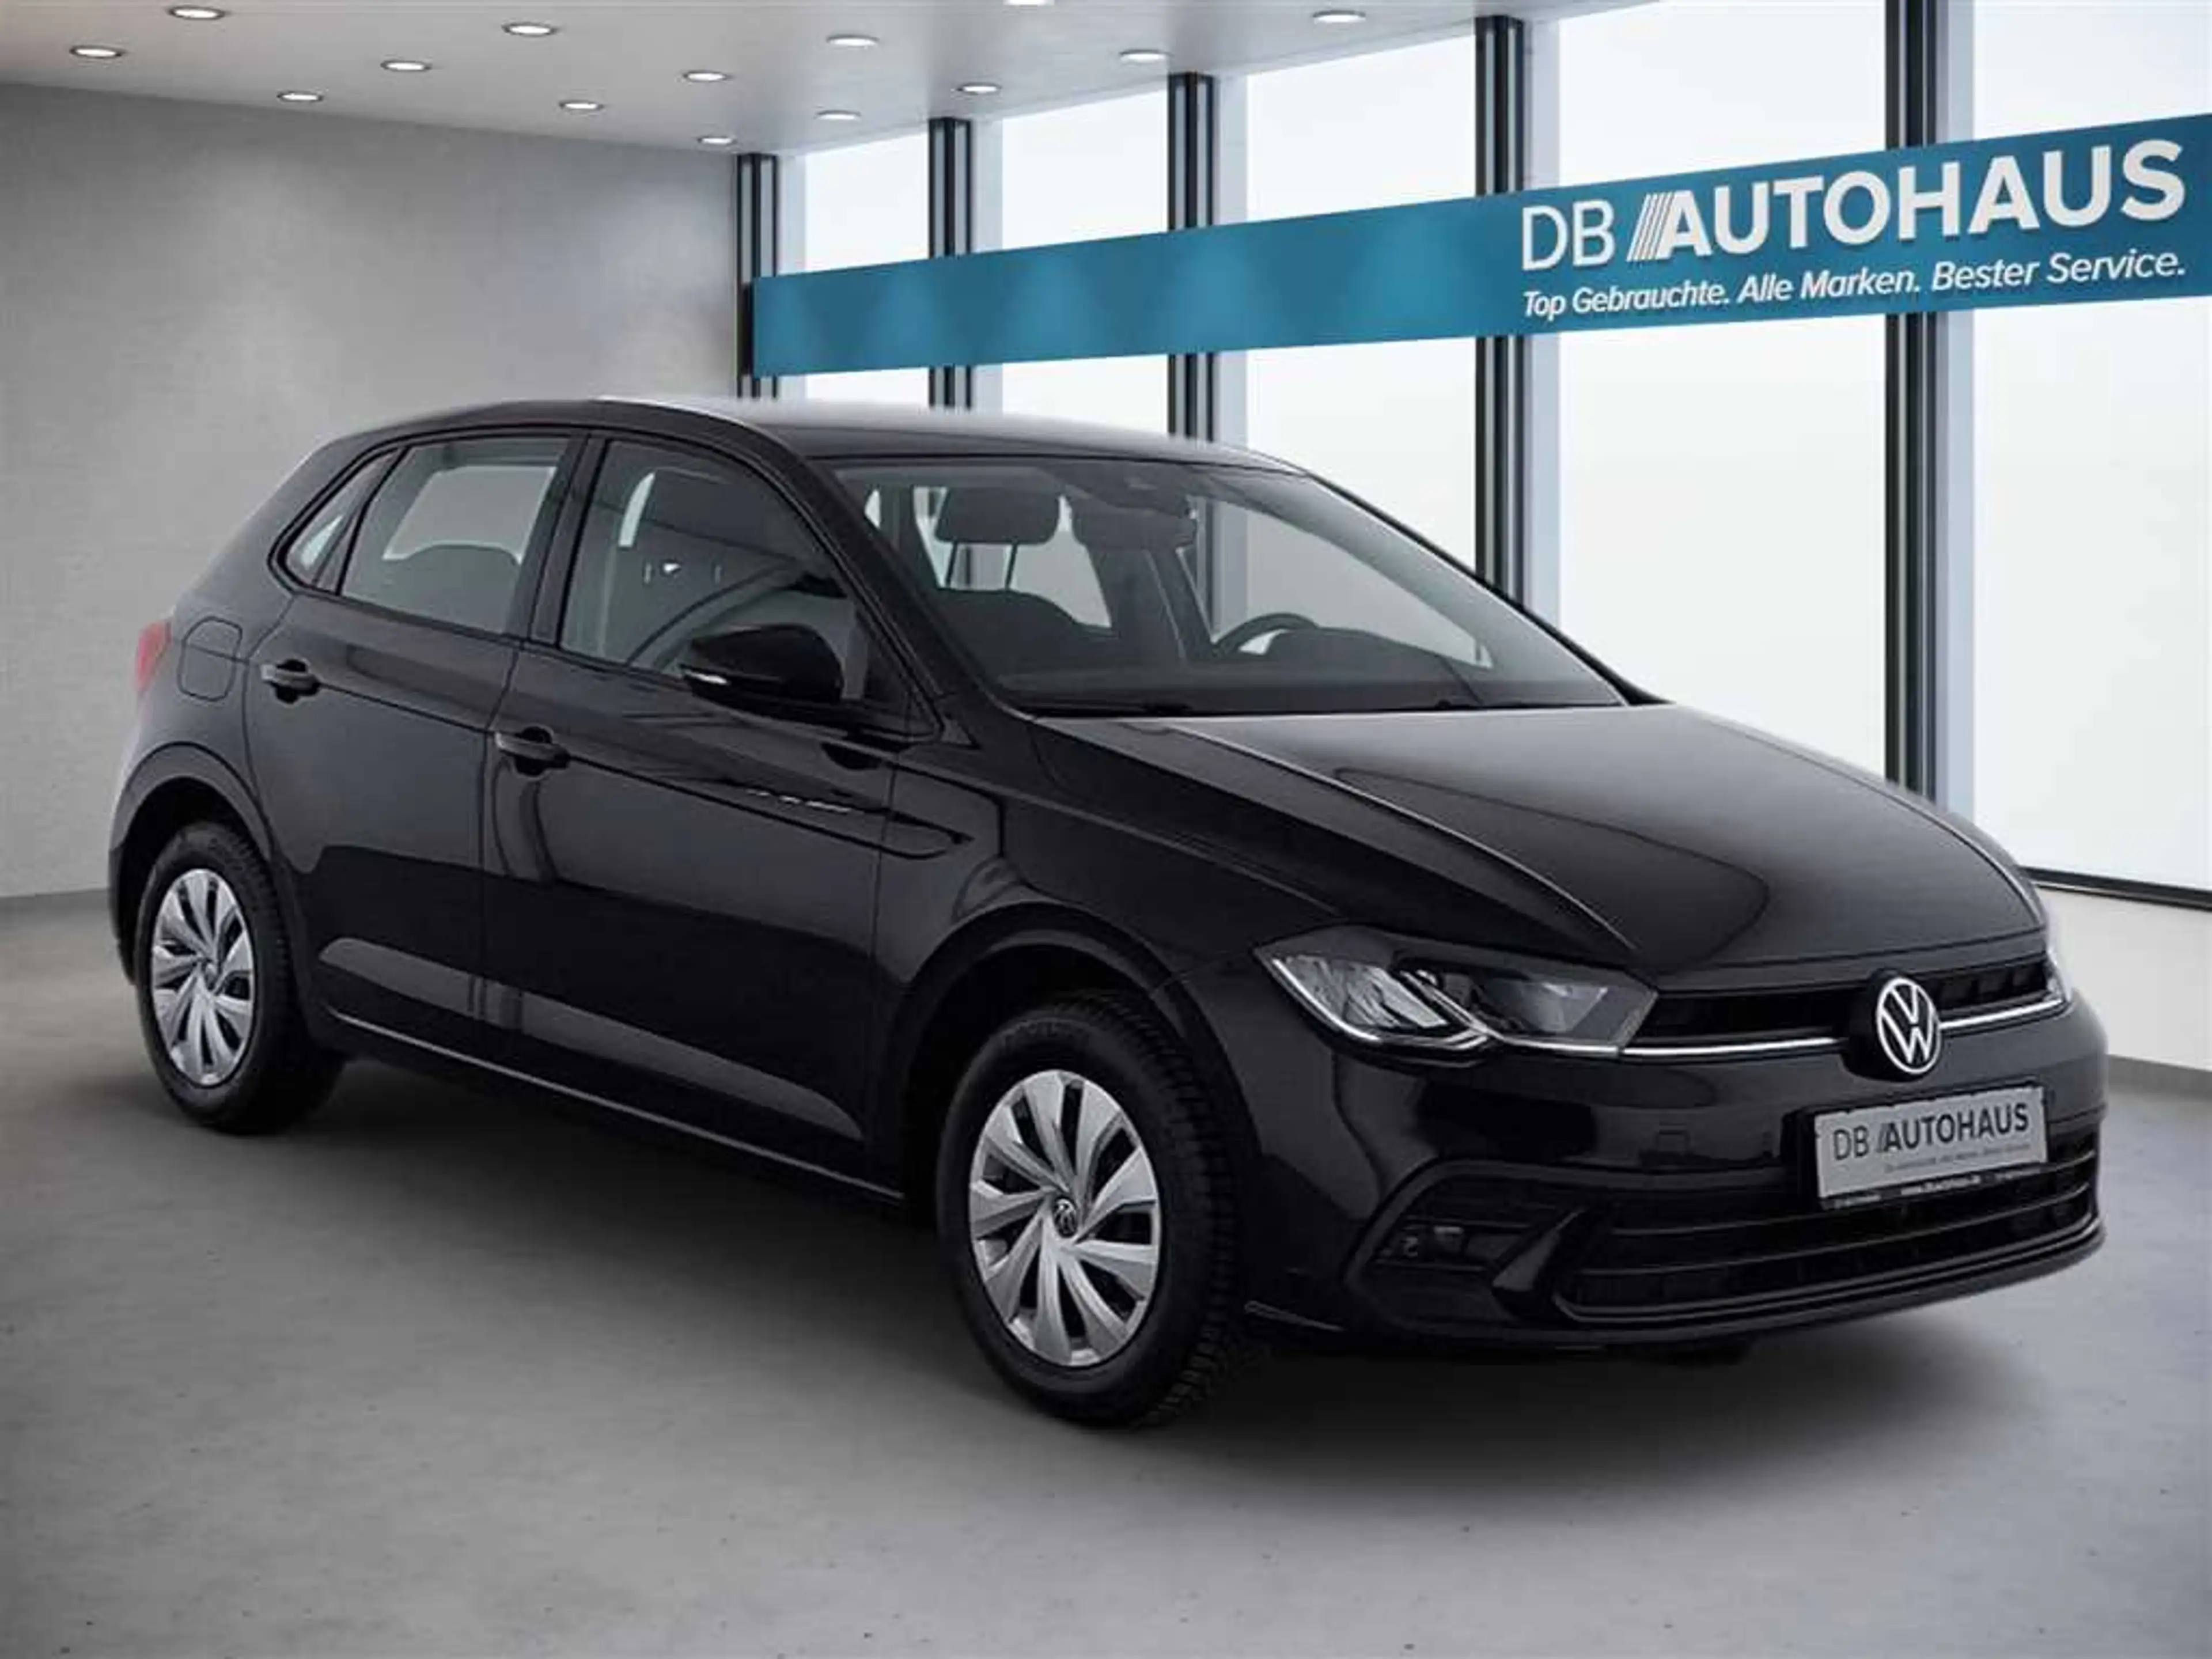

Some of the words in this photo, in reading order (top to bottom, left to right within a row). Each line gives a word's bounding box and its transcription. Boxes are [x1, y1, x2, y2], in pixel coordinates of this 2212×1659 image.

[1521, 199, 1615, 271] DB
[1626, 138, 2185, 263] AUTOHAUS
[1524, 290, 1566, 321] Top
[1572, 280, 1729, 315] Gebrauchte.
[1736, 272, 1794, 304] Alle
[1800, 266, 1921, 300] Marken.
[1931, 258, 2040, 291] Bester
[2046, 248, 2186, 284] Service.
[1833, 1124, 1869, 1161] DB
[1879, 1102, 2029, 1153] AUTOHAUS
